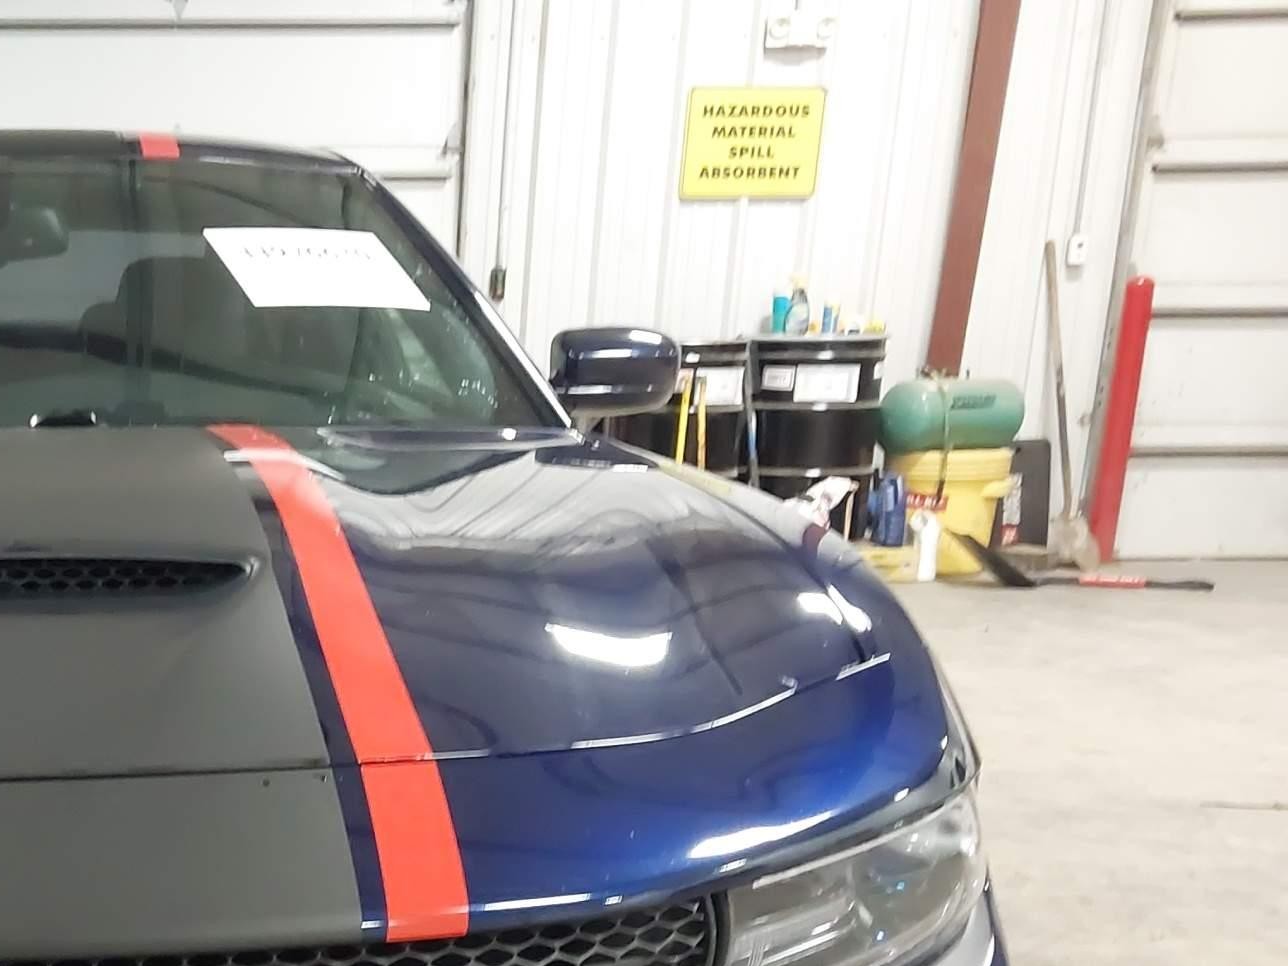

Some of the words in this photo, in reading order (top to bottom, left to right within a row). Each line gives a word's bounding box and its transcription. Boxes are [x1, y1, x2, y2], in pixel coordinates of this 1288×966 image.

[703, 105, 810, 118] HAZARDOUS
[712, 126, 795, 138] MATERIAL
[729, 145, 774, 158] SPILL
[699, 166, 800, 179] ABSORBENT
